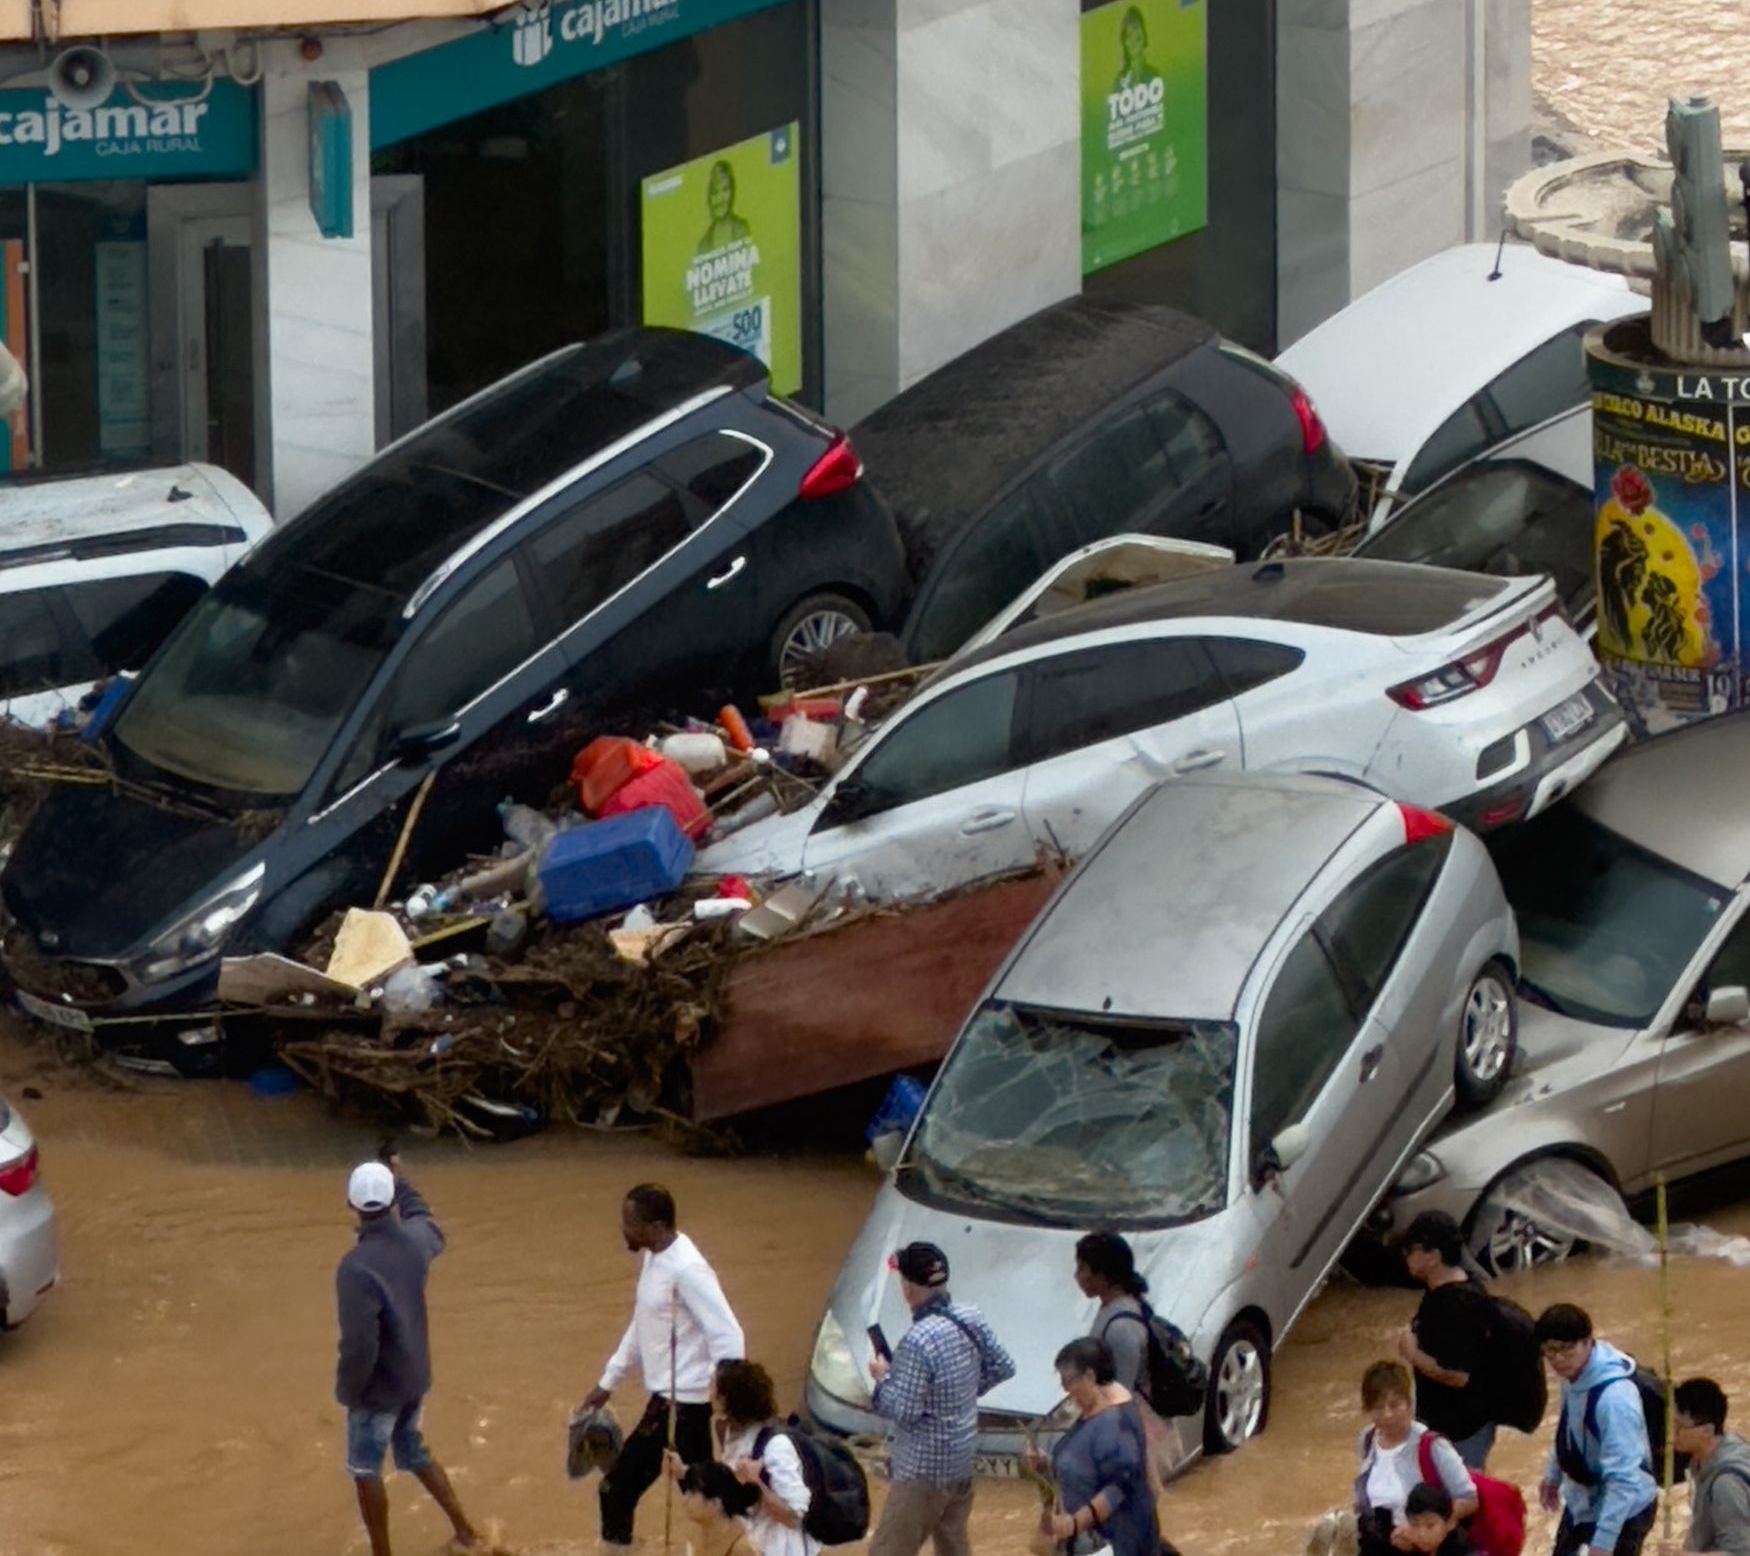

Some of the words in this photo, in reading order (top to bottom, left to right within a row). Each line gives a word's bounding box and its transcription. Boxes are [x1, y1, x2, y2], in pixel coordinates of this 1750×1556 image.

[96, 139, 141, 156] CAJA
[146, 135, 203, 153] RURAL
[1677, 376, 1713, 400] LA
[1645, 404, 1725, 441] ALASKA
